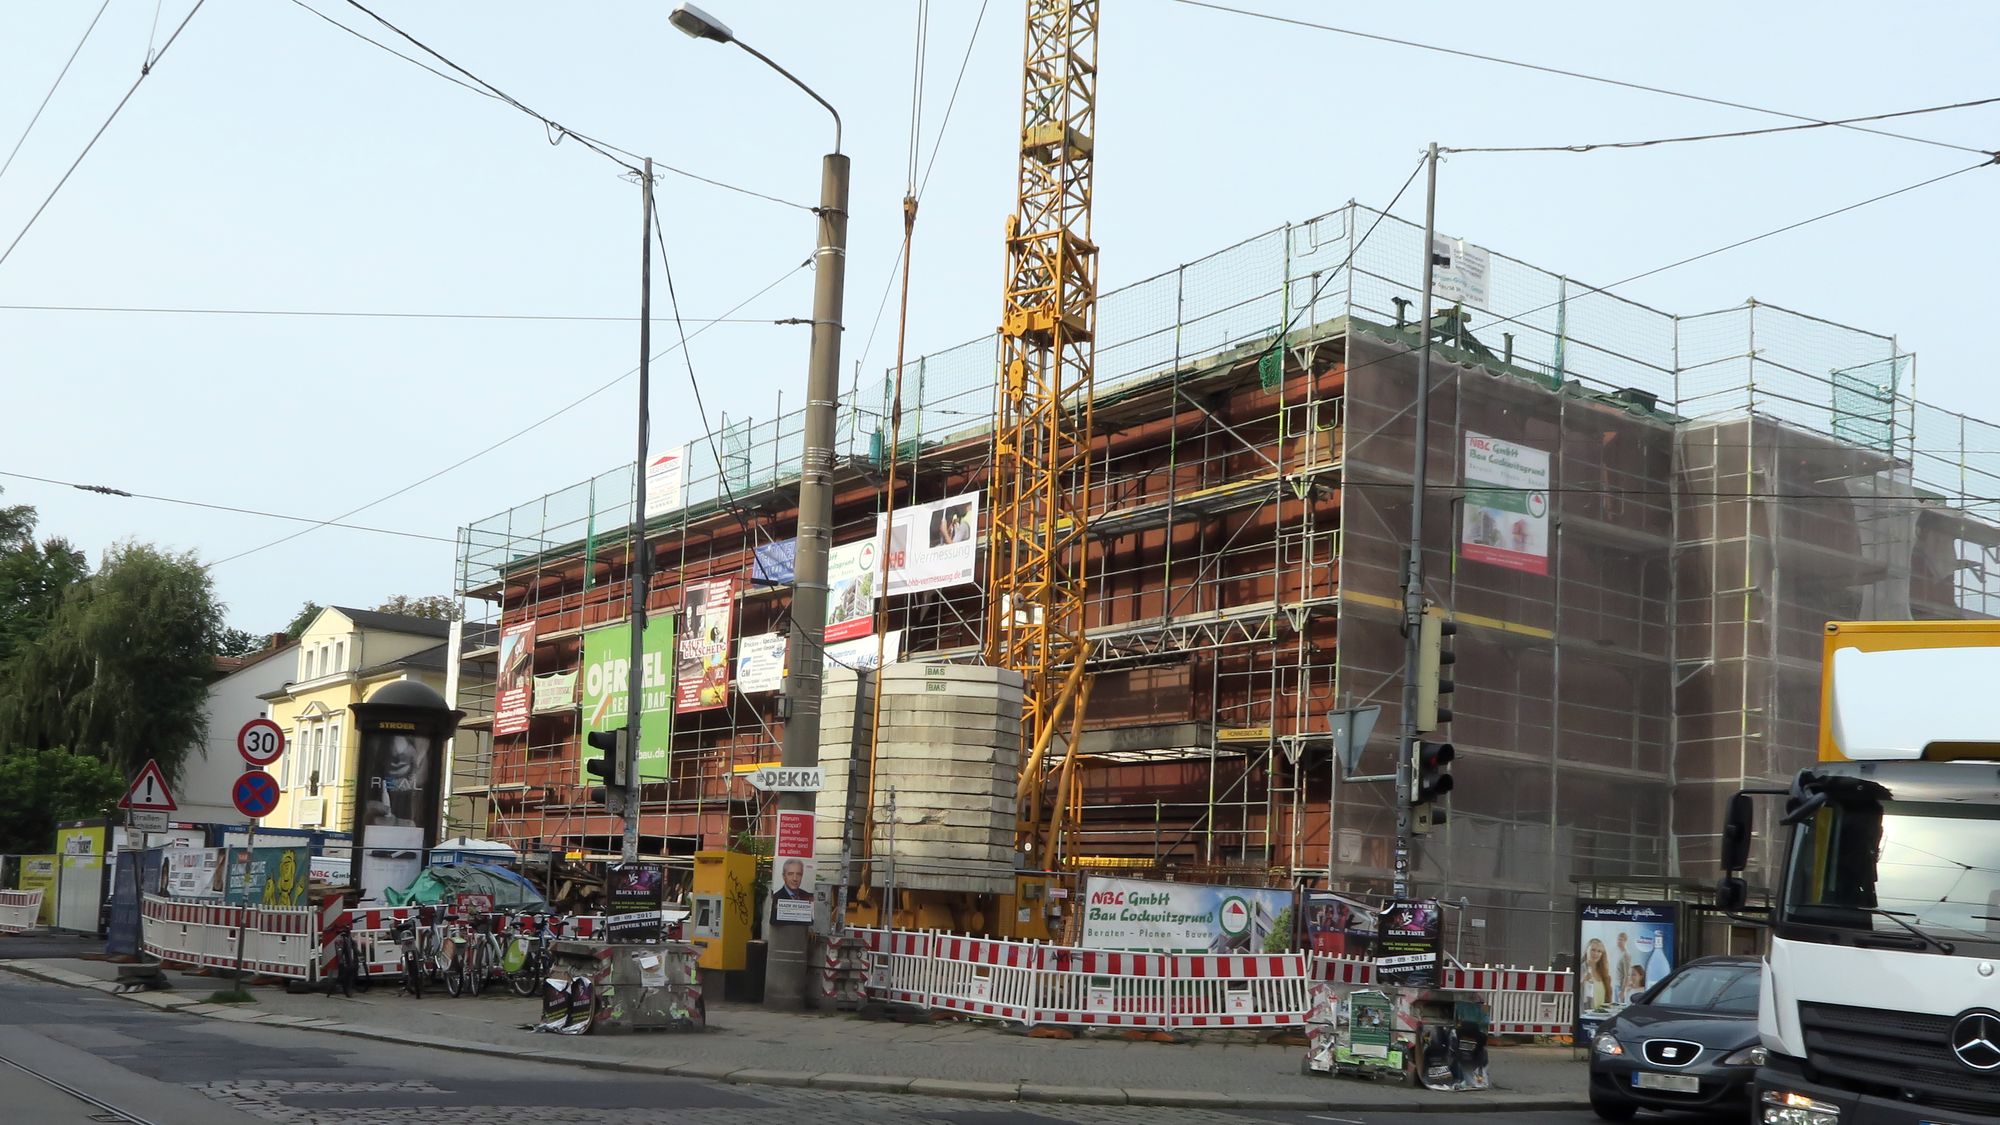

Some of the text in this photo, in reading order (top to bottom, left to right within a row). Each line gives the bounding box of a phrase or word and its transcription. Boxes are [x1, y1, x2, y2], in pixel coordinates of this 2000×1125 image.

[915, 545, 971, 565] Vermessung
[587, 651, 666, 697] OEREL
[927, 667, 946, 676] BMS
[928, 683, 947, 692] BMS
[247, 731, 275, 754] 30
[765, 771, 820, 787] DEKRA
[1128, 891, 1171, 906] GmbH
[1089, 907, 1214, 926] Bau Lockwitzgrund
[1402, 912, 1413, 926] VS
[1088, 928, 1125, 938] Beraten
[1139, 929, 1171, 938] Planen
[1185, 930, 1213, 938] Bauen
[1411, 954, 1427, 962] 2017
